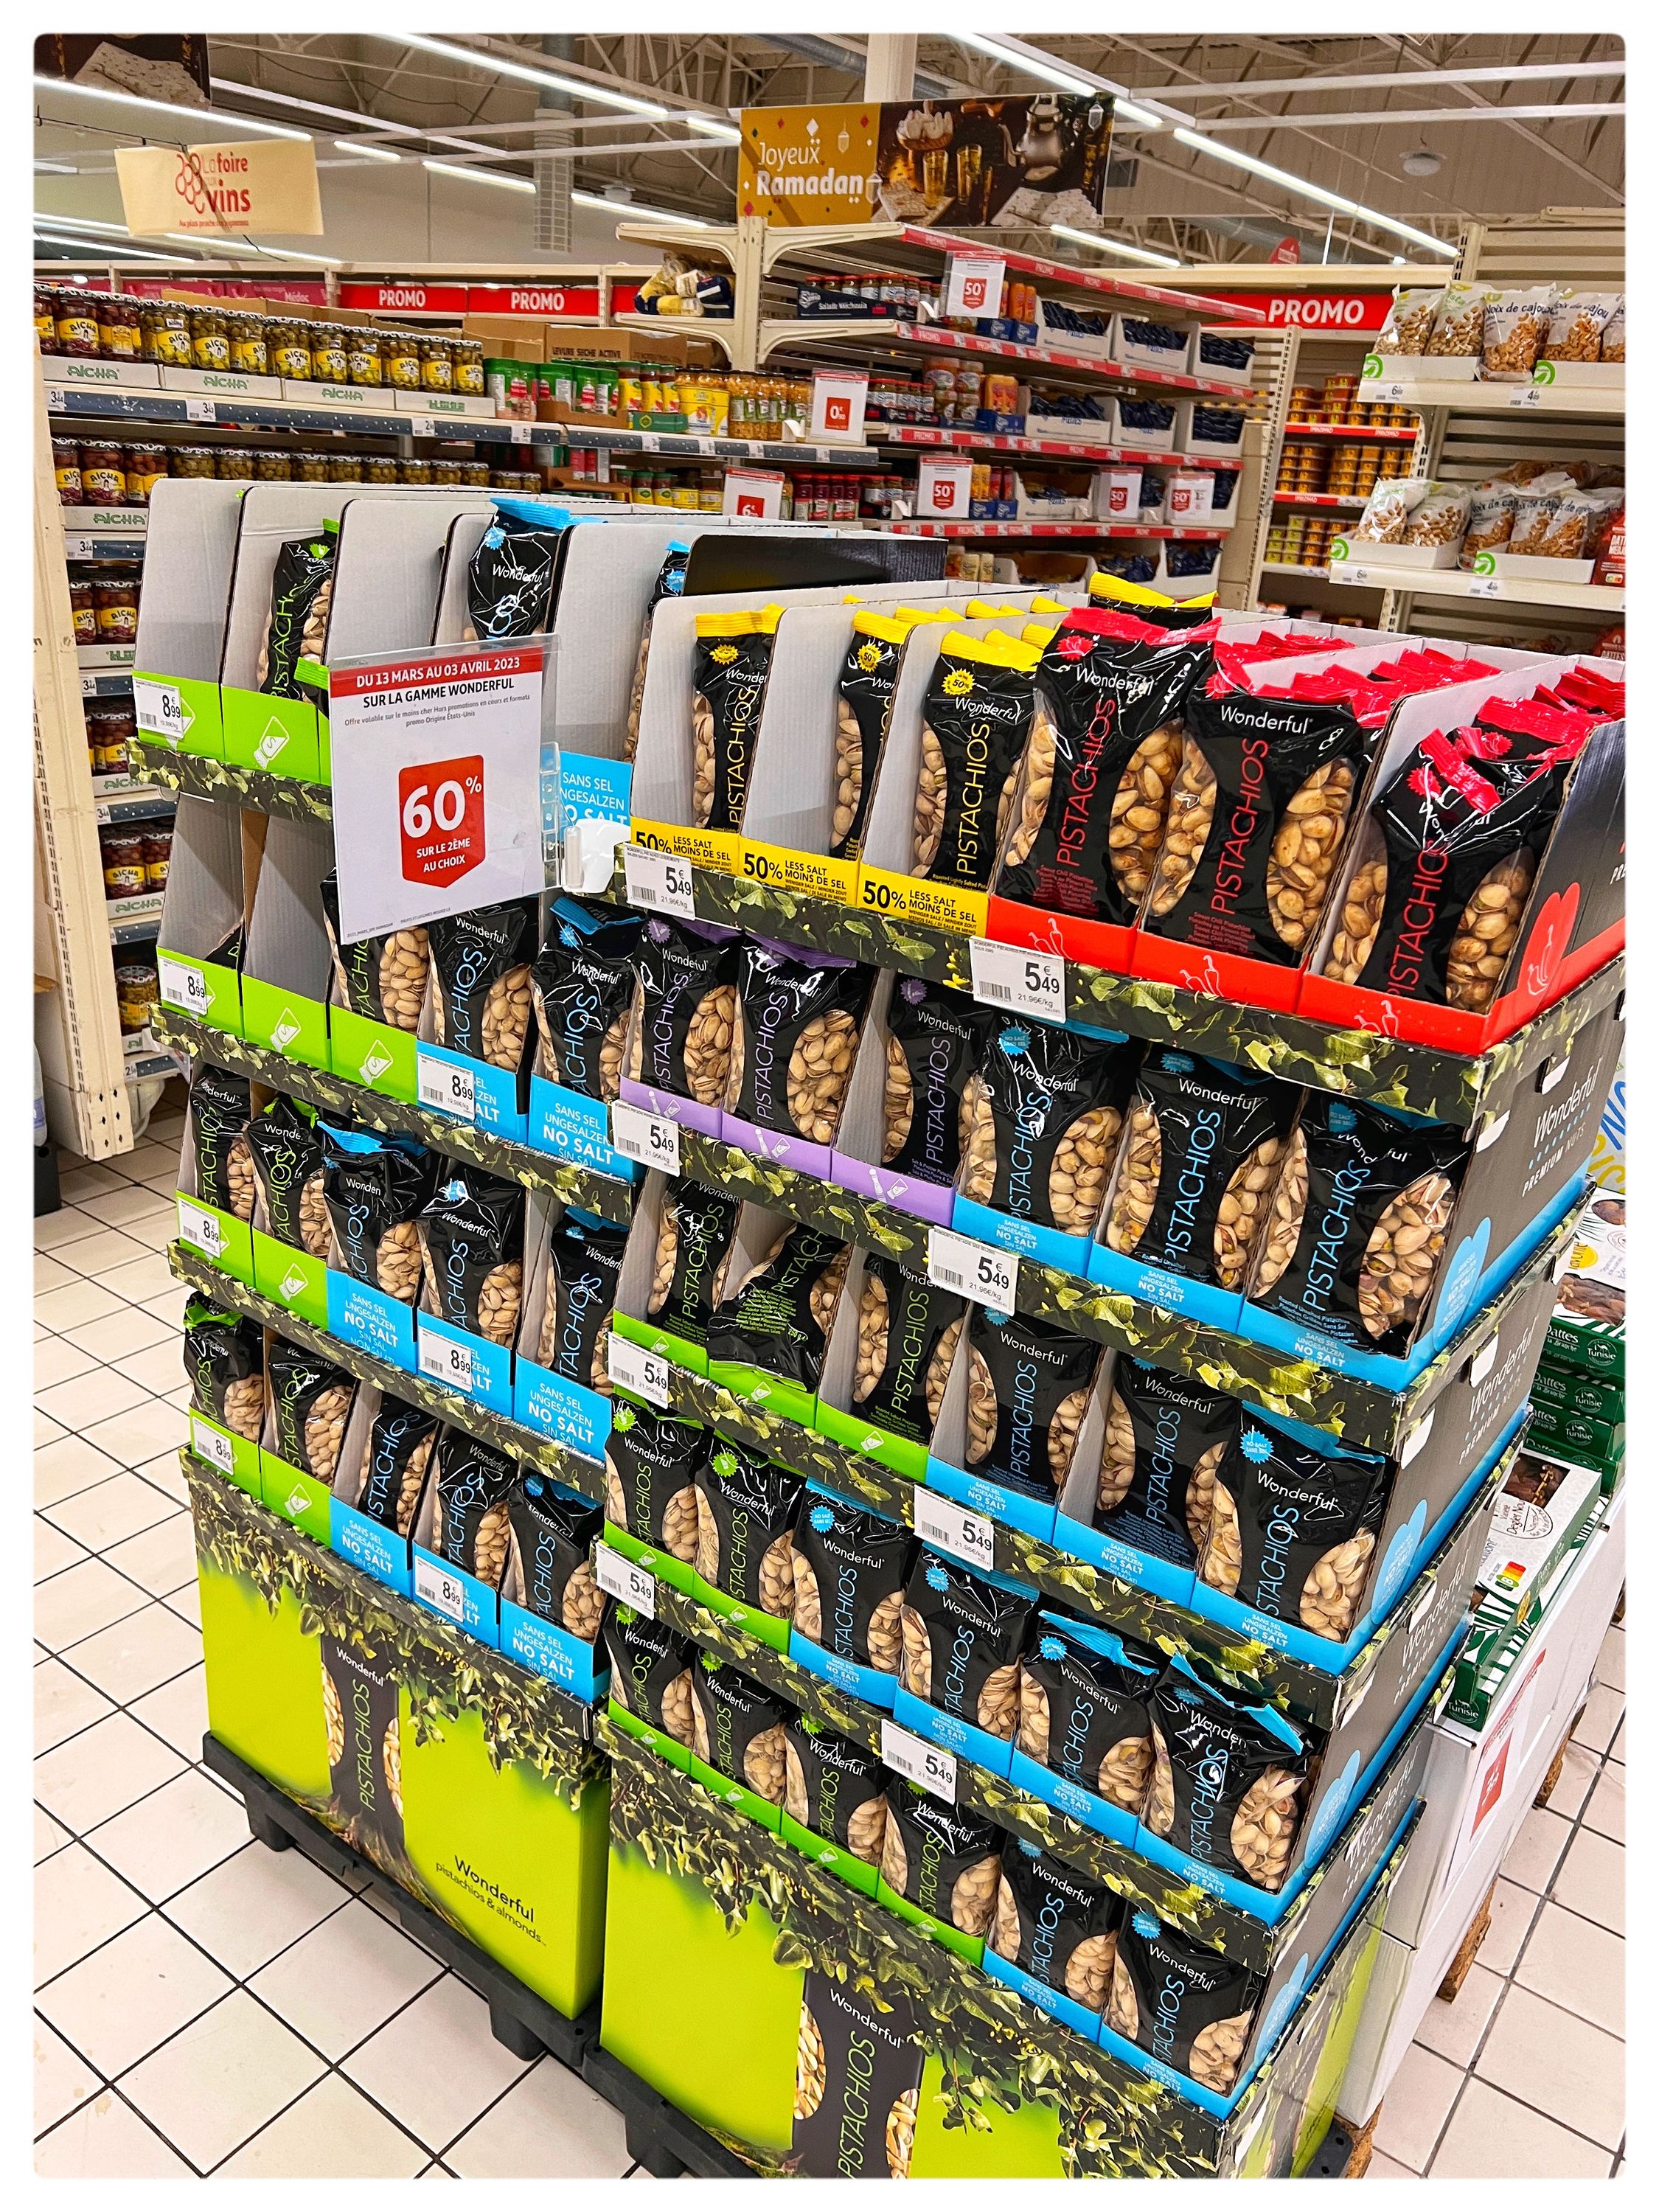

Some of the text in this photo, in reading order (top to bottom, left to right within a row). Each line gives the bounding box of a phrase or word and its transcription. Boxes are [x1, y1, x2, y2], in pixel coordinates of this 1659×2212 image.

[217, 152, 248, 173] foire
[758, 142, 819, 171] Joyeux
[206, 178, 251, 212] vins
[757, 168, 863, 195] Ramadan
[379, 290, 425, 307] PROMO
[511, 292, 565, 310] PROMO
[1268, 300, 1364, 324] PROMO
[1506, 303, 1519, 313] de
[357, 657, 520, 688] DU 13 MARS AU 03 AVRIL 2023
[363, 677, 514, 708] SUR LA GAMME WONDERFUL
[344, 717, 360, 726] Offre
[361, 714, 383, 725] valable
[396, 710, 401, 719] le
[402, 708, 420, 718] moins
[420, 706, 433, 716] cher
[434, 703, 447, 713] Hors
[448, 700, 479, 713] promotions
[487, 698, 502, 706] cours
[503, 695, 509, 703] et
[509, 693, 530, 702] formats
[406, 709, 475, 728] promo Origine États-Unis
[1220, 704, 1310, 734] Wonderful
[563, 772, 613, 792] SANS SEL
[957, 723, 990, 874] PISTACHIOS
[1057, 698, 1116, 867] PISTACHIOS
[403, 776, 482, 838] 60%
[673, 836, 694, 846] LESS
[695, 839, 712, 849] SALT
[1211, 738, 1268, 915] PISTACHIOS
[417, 837, 470, 858] SUR LE 2ÈME
[423, 854, 465, 873] AU CHOIX
[673, 845, 701, 857] MOINS
[703, 849, 714, 858] DE
[717, 851, 731, 860] SEL
[743, 852, 827, 880] 50% LESS SALT
[785, 869, 846, 889] MOINS DE SEL
[863, 880, 956, 911] 50% LESS SALT
[909, 899, 976, 922] MOINS DE SEL
[455, 916, 505, 944] Wonderful
[755, 992, 788, 1121] PISTACHIOS
[555, 1103, 601, 1130] SANS SEL
[925, 1036, 950, 1165] PISTACHIOS
[543, 1124, 613, 1164] NO SALT
[546, 1111, 611, 1147] UNGESALZEN
[1522, 1122, 1585, 1197] PREMIUM NUTS
[1302, 1159, 1371, 1312] PISTACHIOS
[346, 1300, 396, 1332] UNGESALZEN
[352, 1293, 387, 1318] SANS SEL
[345, 1311, 398, 1348] NO SALT
[891, 1289, 929, 1414] PISTACHIOS
[1001, 1330, 1065, 1366] Wonderful
[1295, 1343, 1345, 1367] NO SALT
[1587, 1347, 1616, 1360] Tunisie
[530, 1390, 591, 1427] UNGESALZEN
[540, 1383, 582, 1411] SANS SEL
[1145, 1376, 1211, 1415] Wonderful
[1575, 1395, 1602, 1408] Tunisie
[529, 1401, 594, 1444] NO SALT
[543, 1424, 557, 1438] SIN
[1009, 1360, 1037, 1476] PISTACHIOS
[1565, 1427, 1593, 1441] Tunisie
[469, 1444, 507, 1472] Wonderful
[1147, 1406, 1181, 1526] PISTACHIOS
[1256, 1470, 1335, 1512] Wonderful
[342, 1534, 392, 1573] NO SALT
[823, 1538, 883, 1570] Wonderful
[942, 1596, 1001, 1638] Wonderful
[515, 1627, 572, 1666] UNGESALZEN
[523, 1621, 563, 1650] SANS SEL
[336, 1646, 383, 1687] Wonderful
[512, 1637, 574, 1680] NO SALT
[707, 1675, 751, 1714] Wonderful
[1059, 1663, 1118, 1714] Wonderful
[352, 1678, 376, 1812] PISTACHIOS
[454, 1854, 535, 1923] Wonderful
[1032, 1861, 1093, 1908] Wonderful
[436, 1862, 543, 1945] pistachios & almonds
[1148, 1943, 1214, 1992] Wonderful
[830, 1988, 902, 2049] Wonderful
